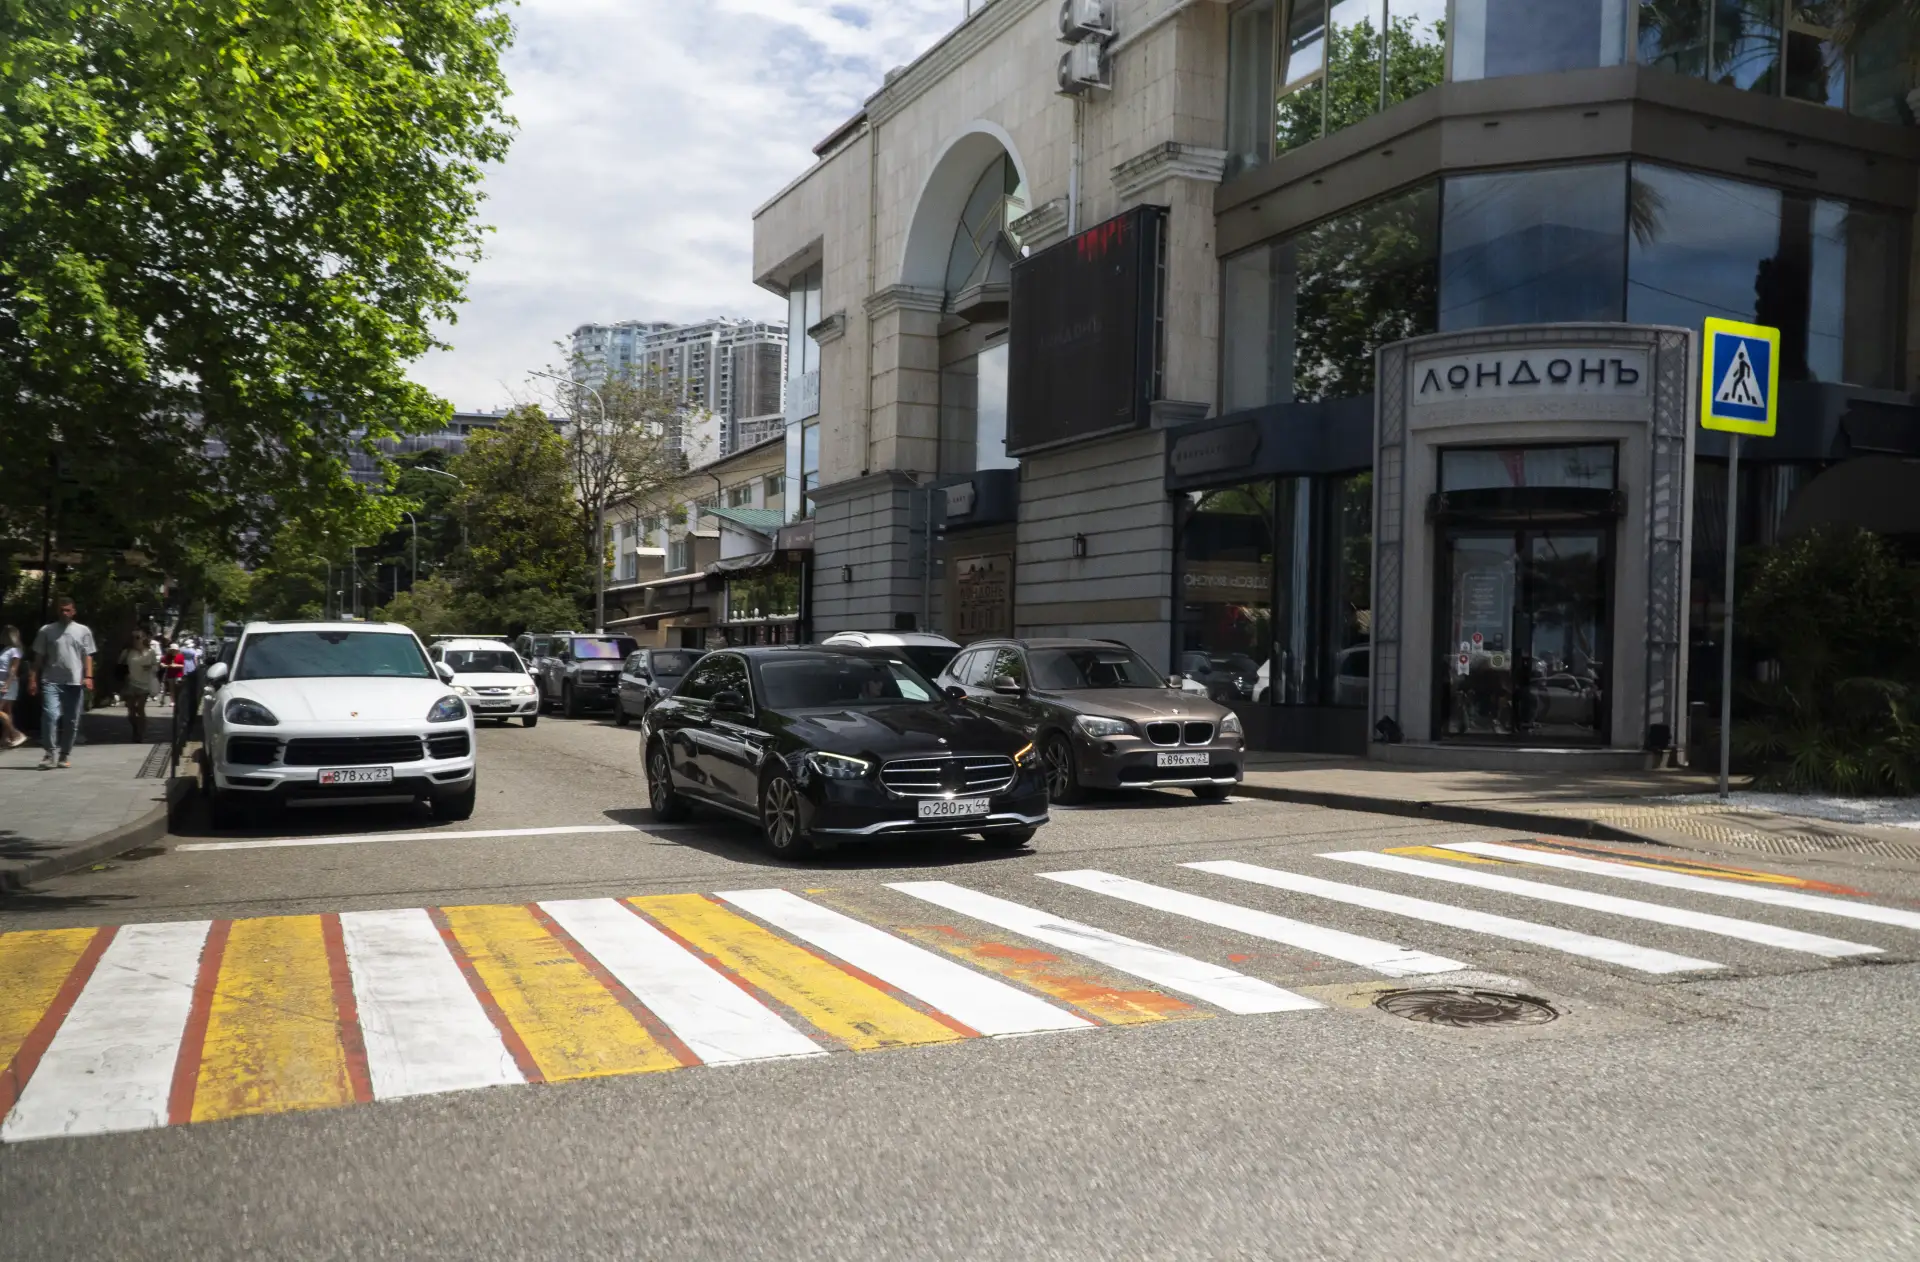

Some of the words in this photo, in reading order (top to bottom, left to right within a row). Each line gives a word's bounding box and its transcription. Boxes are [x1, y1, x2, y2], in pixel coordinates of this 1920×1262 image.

[1420, 358, 1640, 394] ЛОНДОНЪ
[323, 770, 373, 782] 878ХХ
[923, 801, 973, 815] О280РХ
[975, 799, 986, 809] 44
